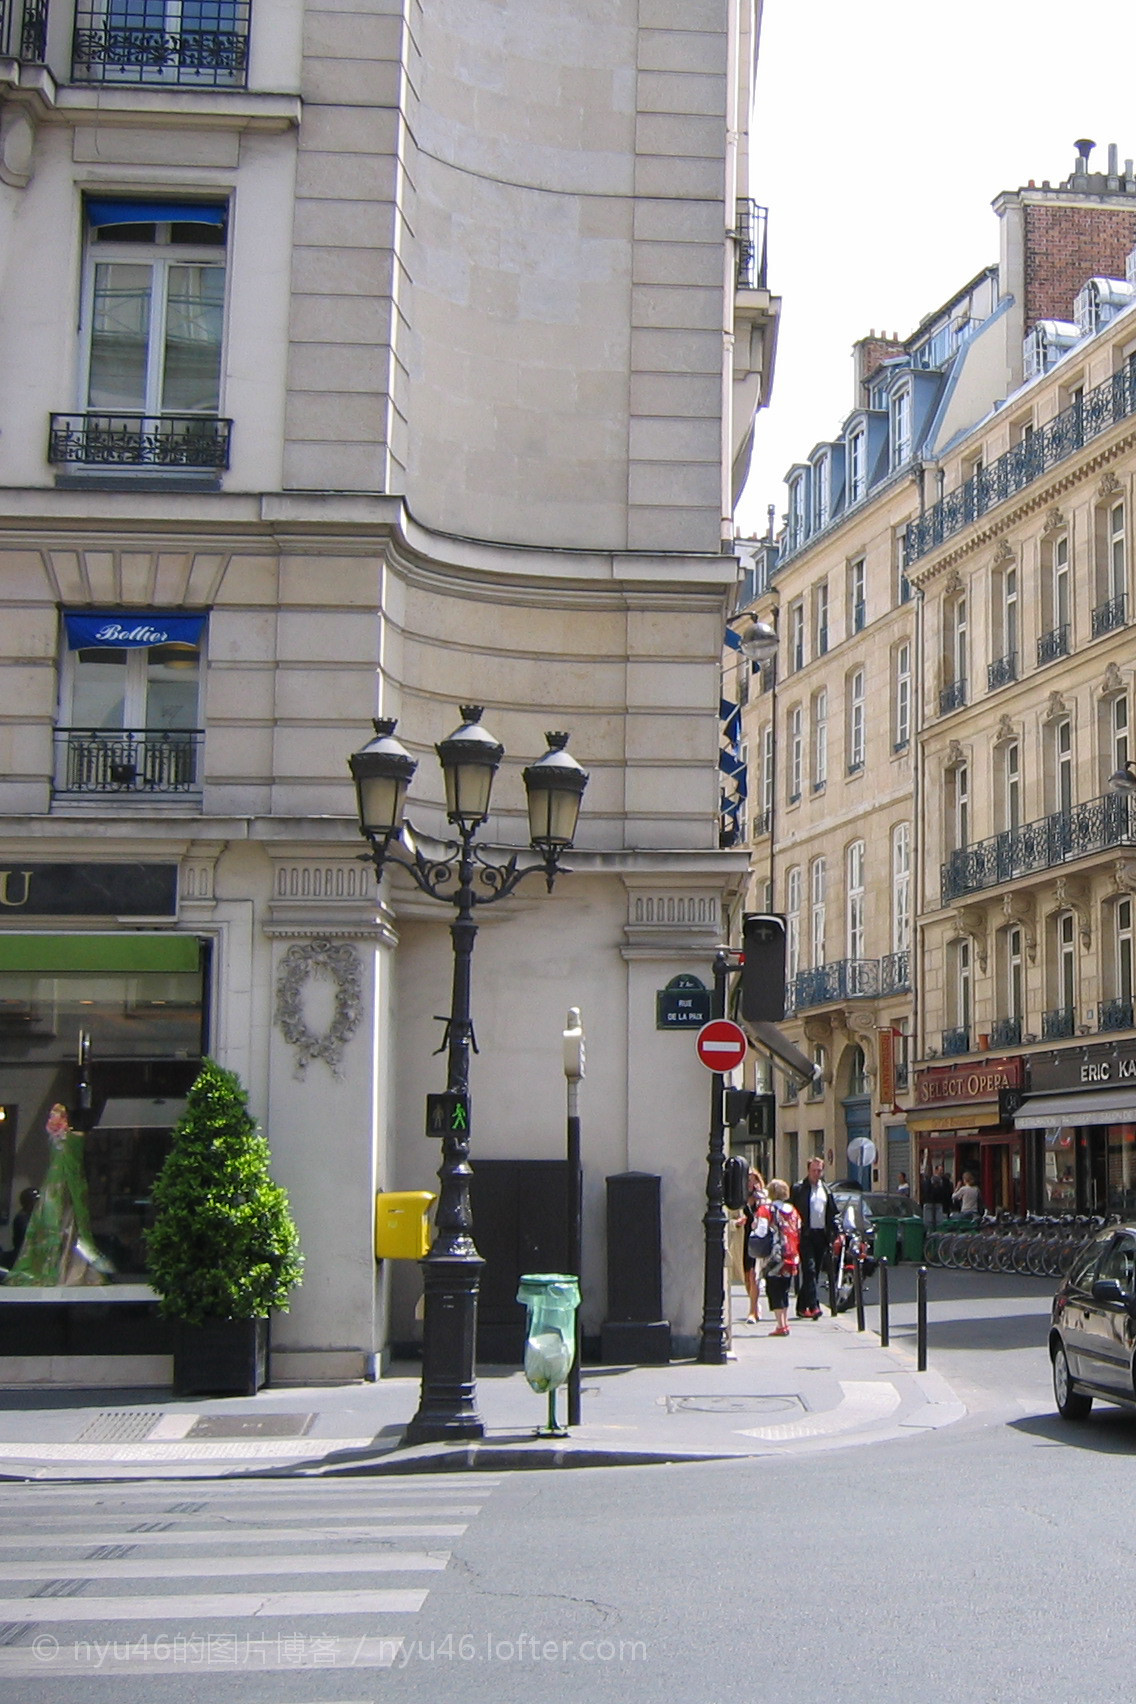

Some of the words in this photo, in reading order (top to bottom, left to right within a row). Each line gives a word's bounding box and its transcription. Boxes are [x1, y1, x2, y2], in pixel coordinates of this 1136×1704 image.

[678, 999, 693, 1008] RUE
[667, 1012, 677, 1021] DE
[678, 1012, 687, 1021] LA
[688, 1012, 704, 1021] PAIX
[1080, 1062, 1110, 1082] ERIC
[921, 1078, 964, 1102] SELECT
